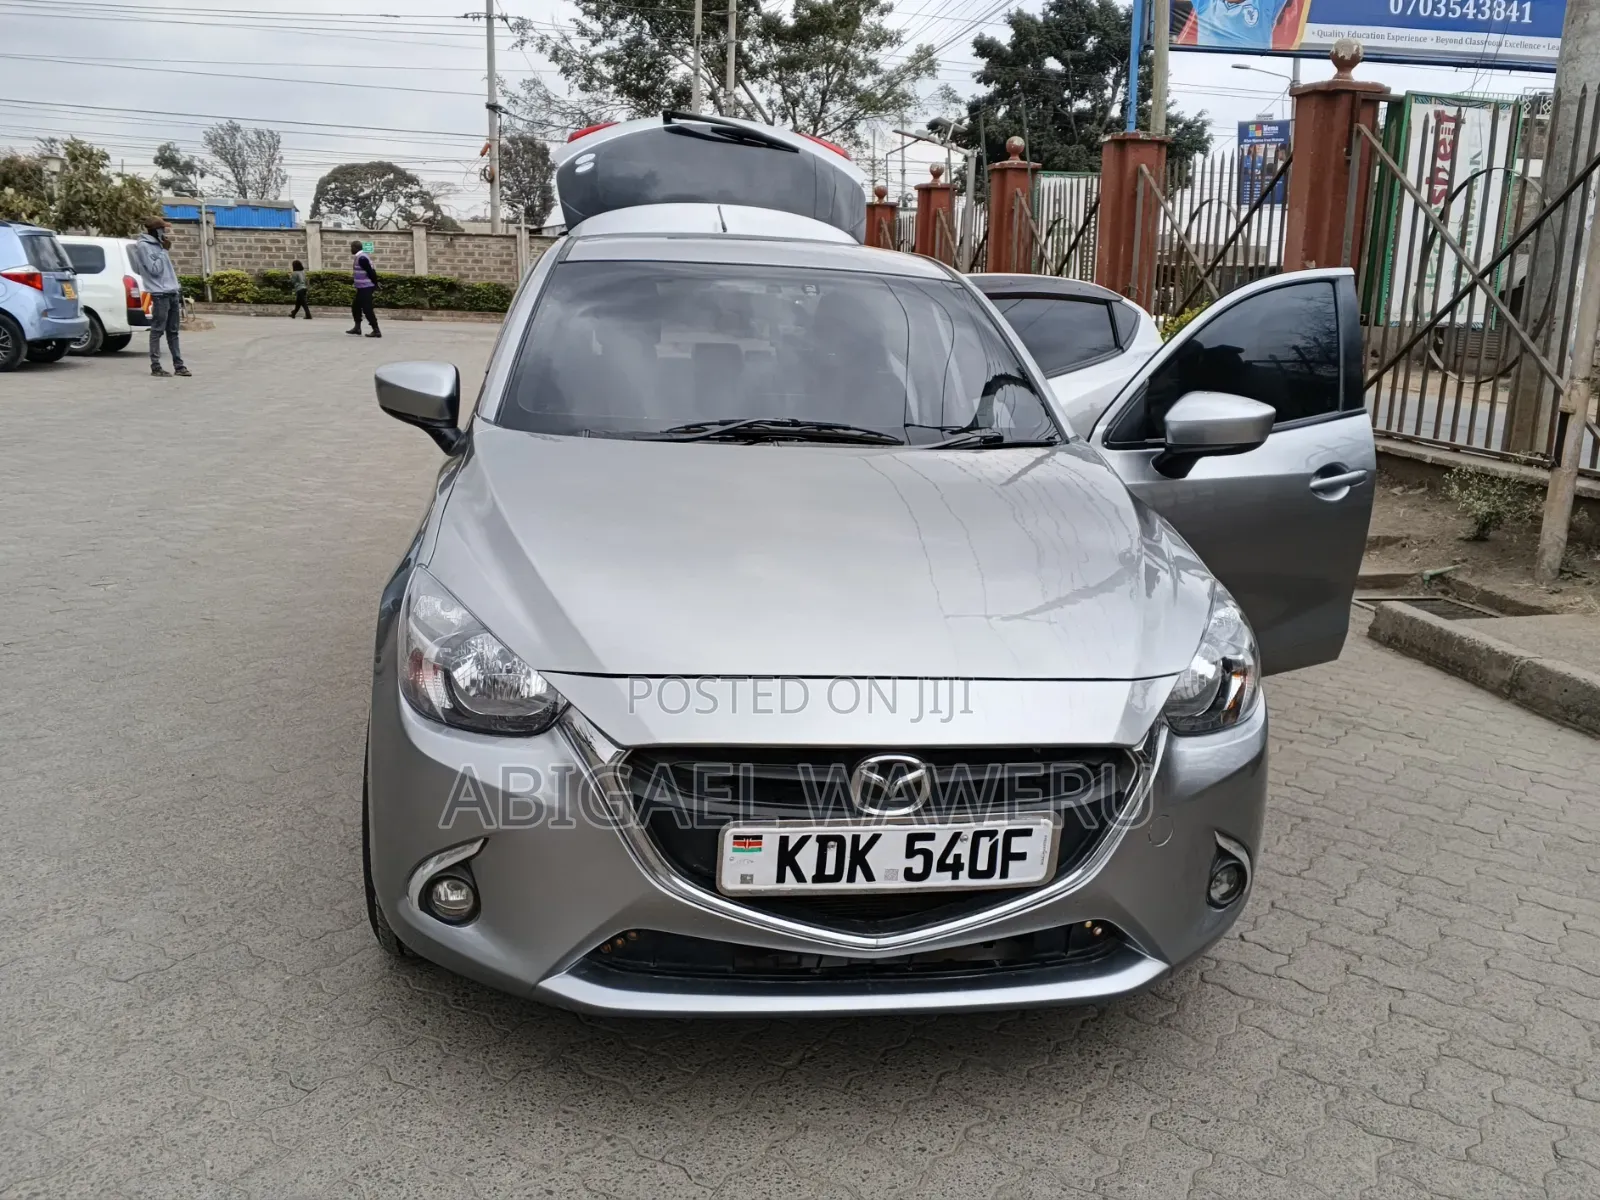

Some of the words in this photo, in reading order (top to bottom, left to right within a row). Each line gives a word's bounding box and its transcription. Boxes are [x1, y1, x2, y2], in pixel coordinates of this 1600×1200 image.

[1389, 0, 1532, 23] 0703543841
[1317, 29, 1345, 39] Quality
[1347, 30, 1385, 40] Education
[1387, 32, 1427, 43] Experience
[1435, 35, 1463, 45] Beyond
[1504, 40, 1541, 49] Excellence
[775, 833, 882, 884] KDK
[903, 828, 1034, 882] 540F
